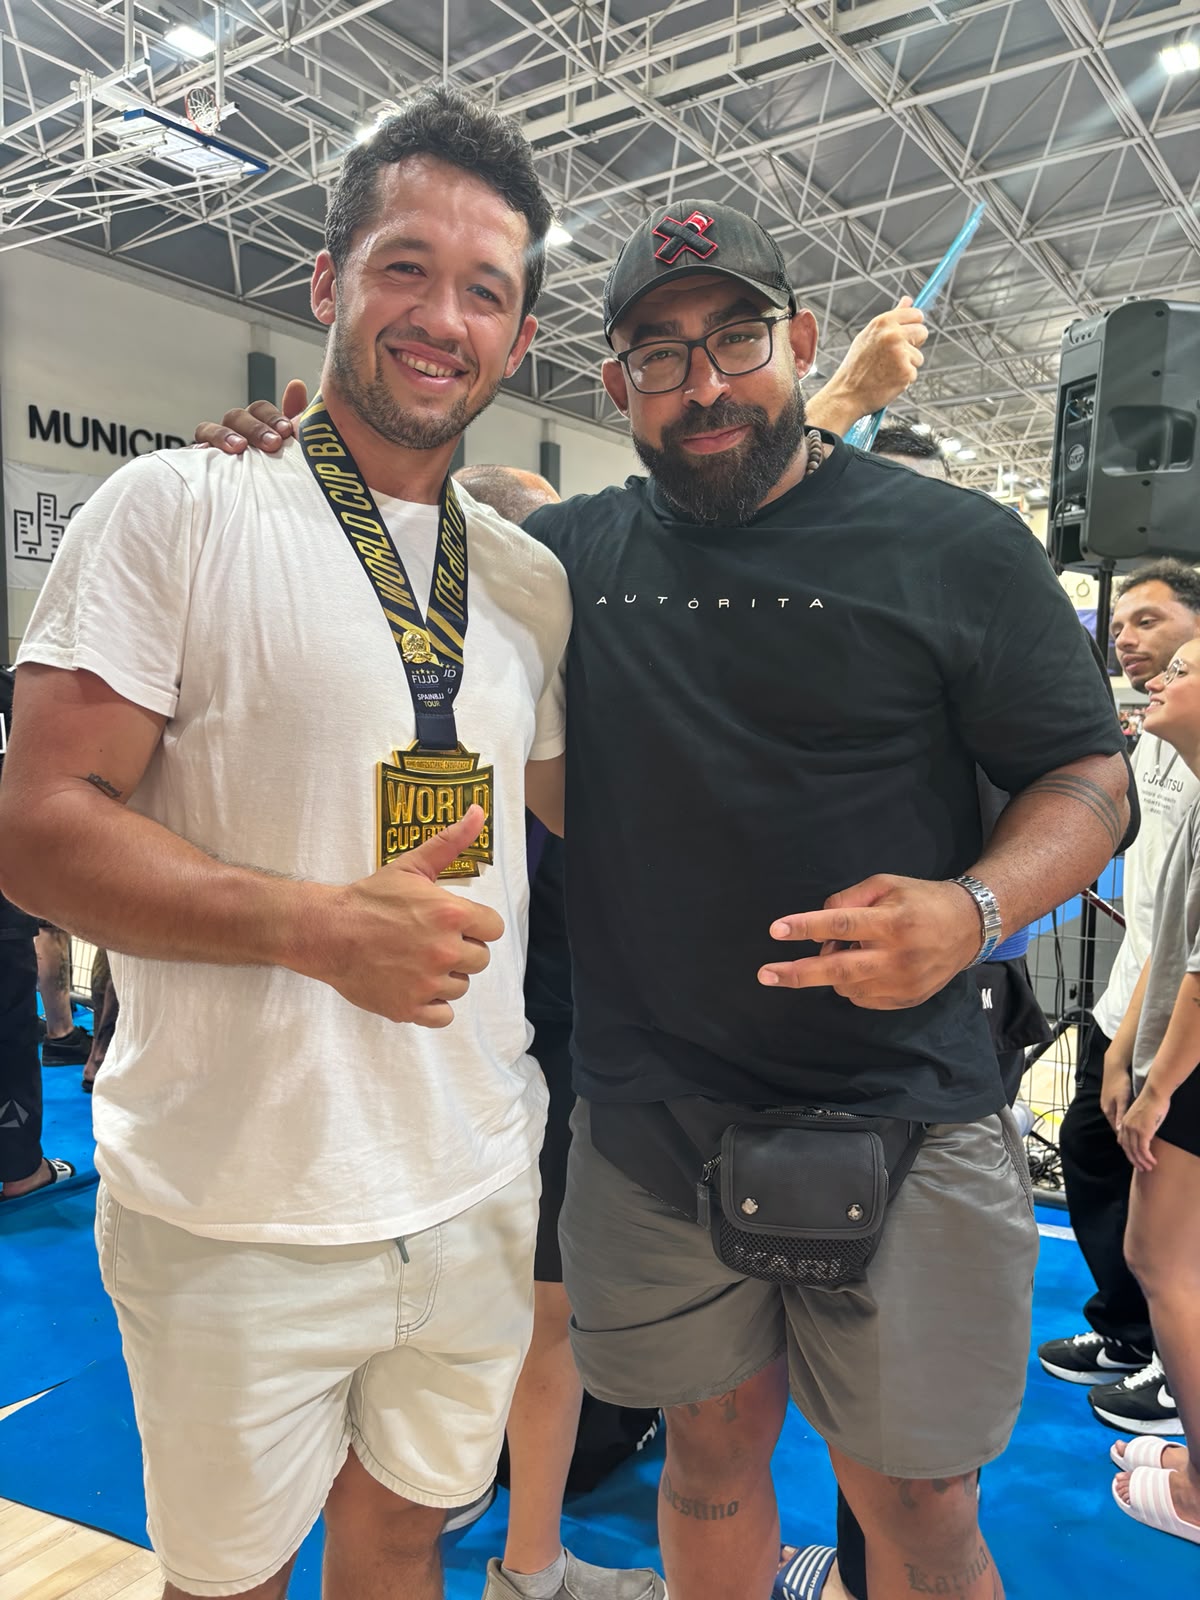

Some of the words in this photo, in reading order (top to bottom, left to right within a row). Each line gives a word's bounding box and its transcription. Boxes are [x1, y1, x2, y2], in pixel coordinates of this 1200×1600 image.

[28, 404, 193, 458] MUNICIP
[302, 422, 347, 457] BJJ
[315, 463, 373, 511] CUP
[340, 511, 416, 611] WORLD
[434, 563, 464, 621] BJJ
[386, 780, 490, 826] WORLD
[386, 824, 421, 853] CUP
